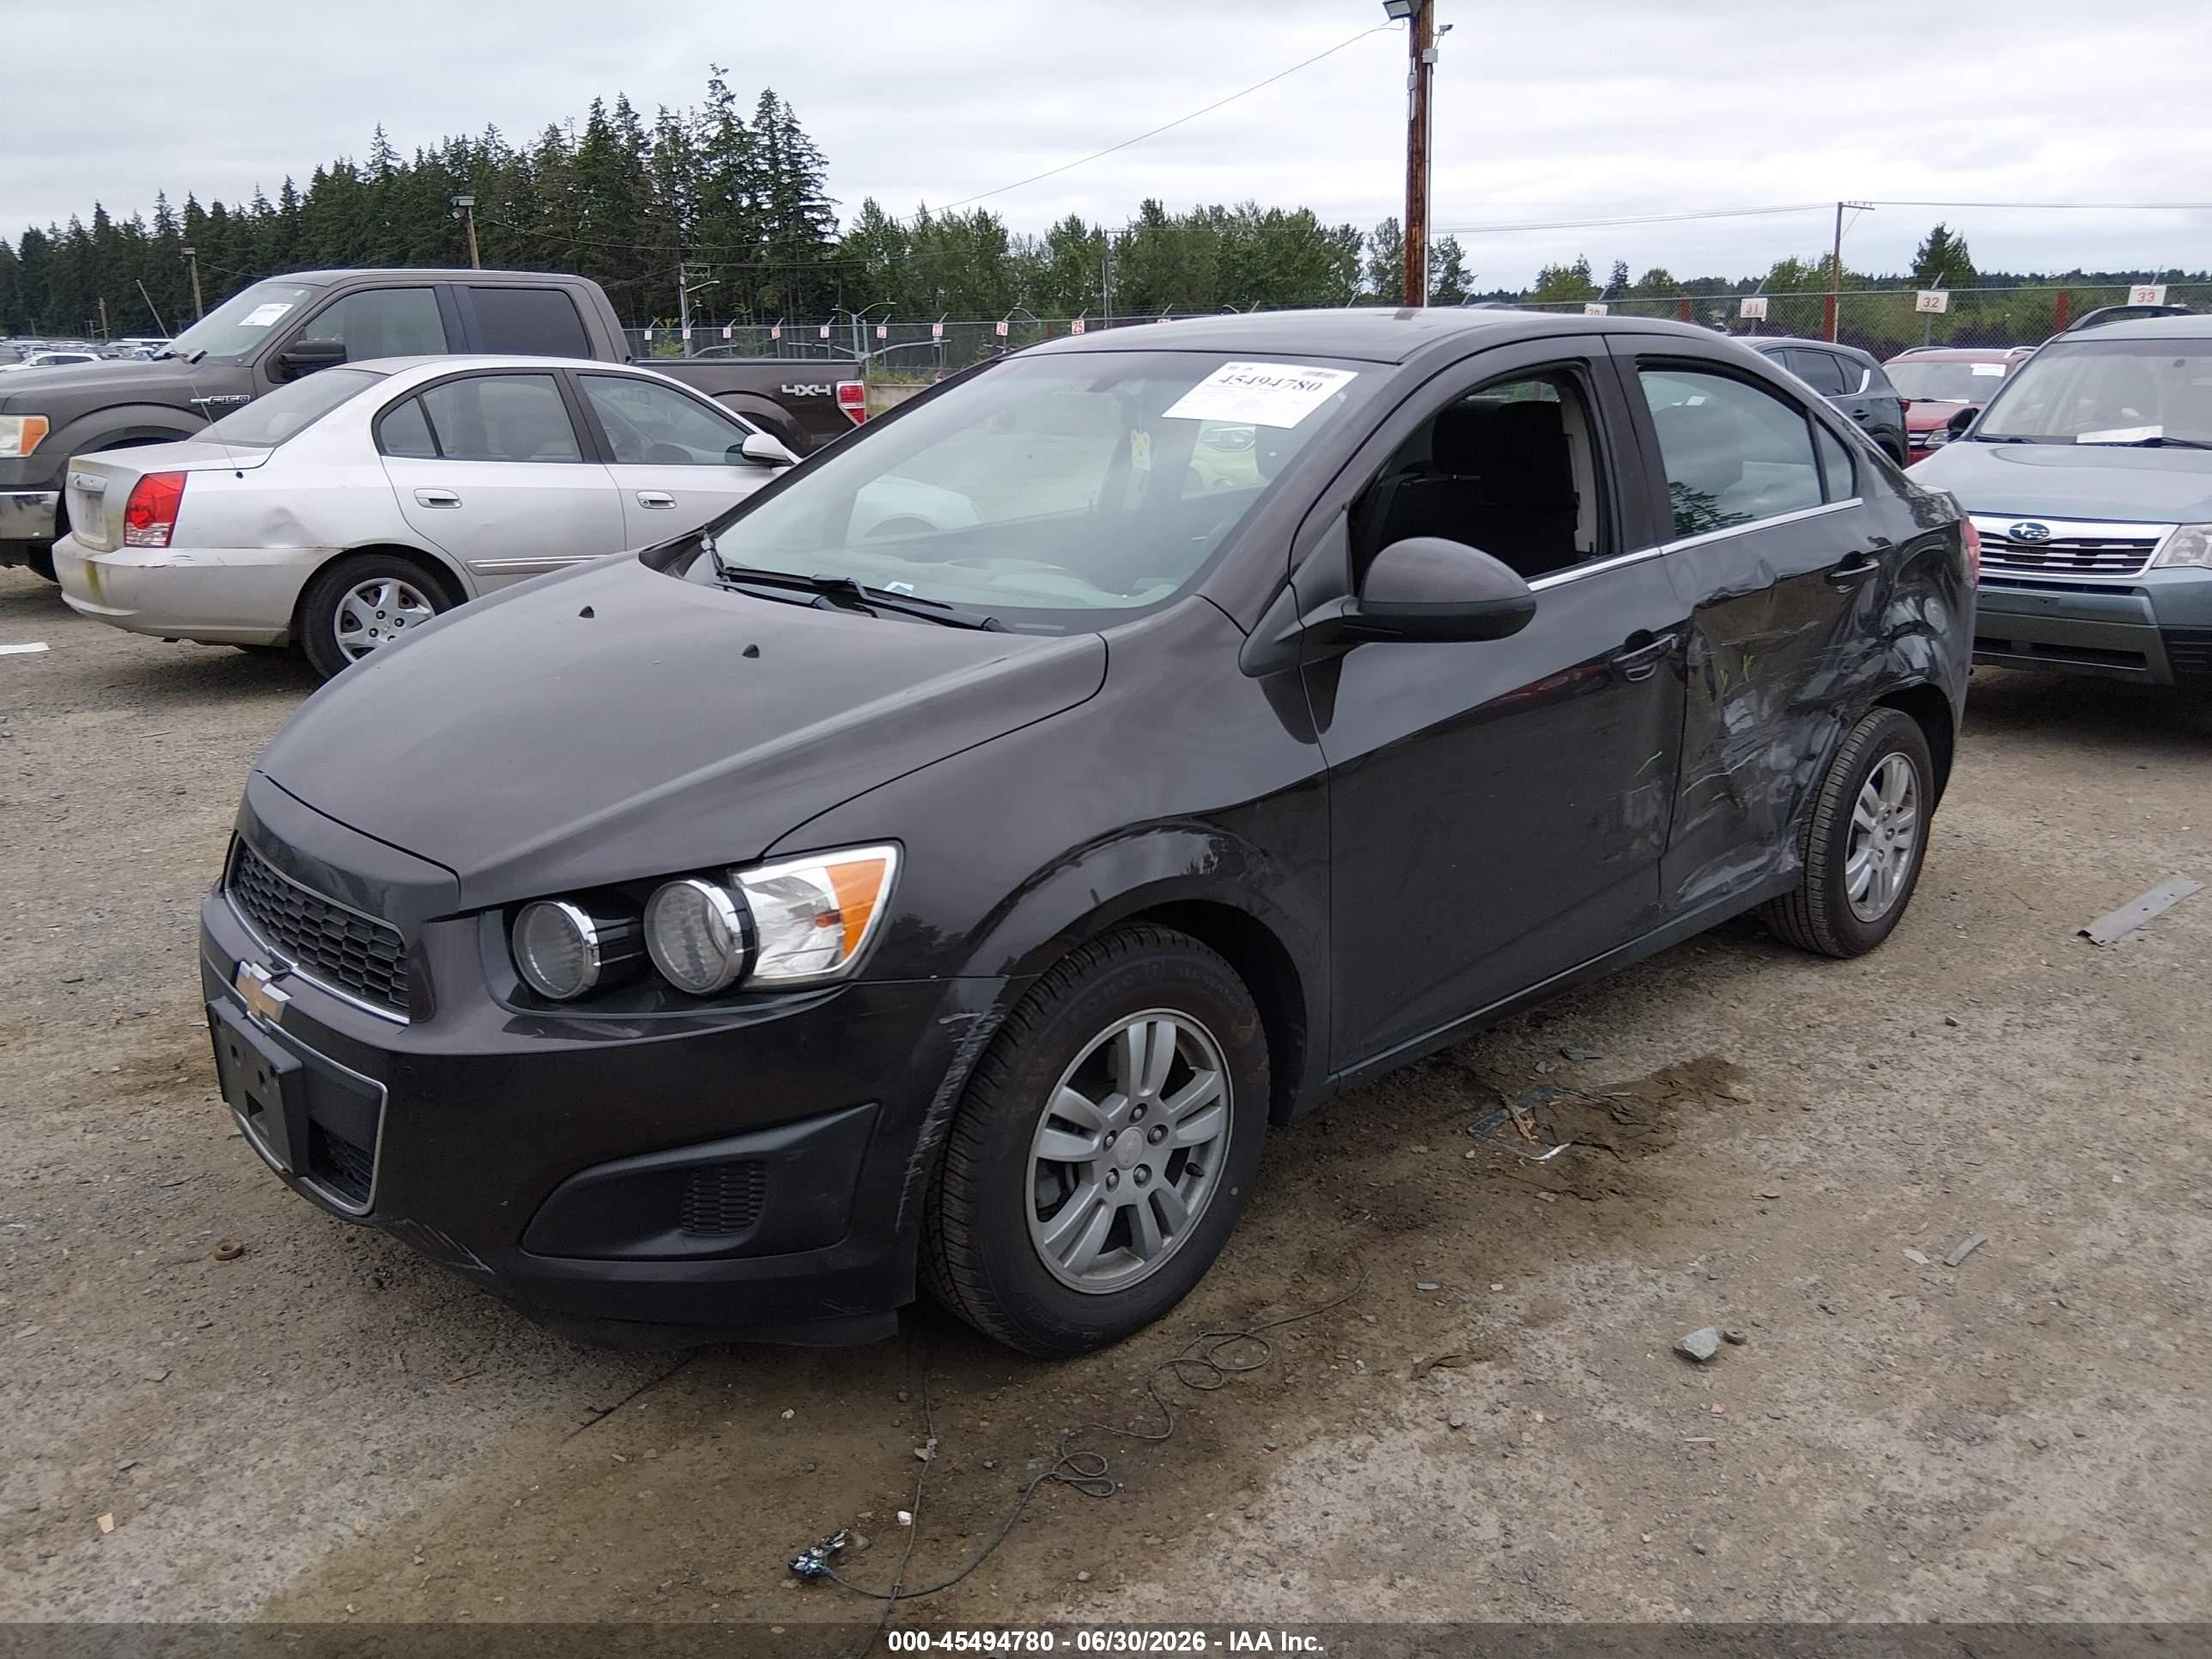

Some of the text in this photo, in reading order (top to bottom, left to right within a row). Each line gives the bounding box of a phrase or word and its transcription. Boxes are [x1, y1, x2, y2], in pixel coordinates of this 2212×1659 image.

[1923, 296, 1939, 308] 32
[2136, 291, 2155, 303] 33
[1746, 303, 1759, 314] 31
[998, 323, 1006, 335] 24
[1073, 321, 1083, 333] 25
[1218, 374, 1323, 392] 45494780
